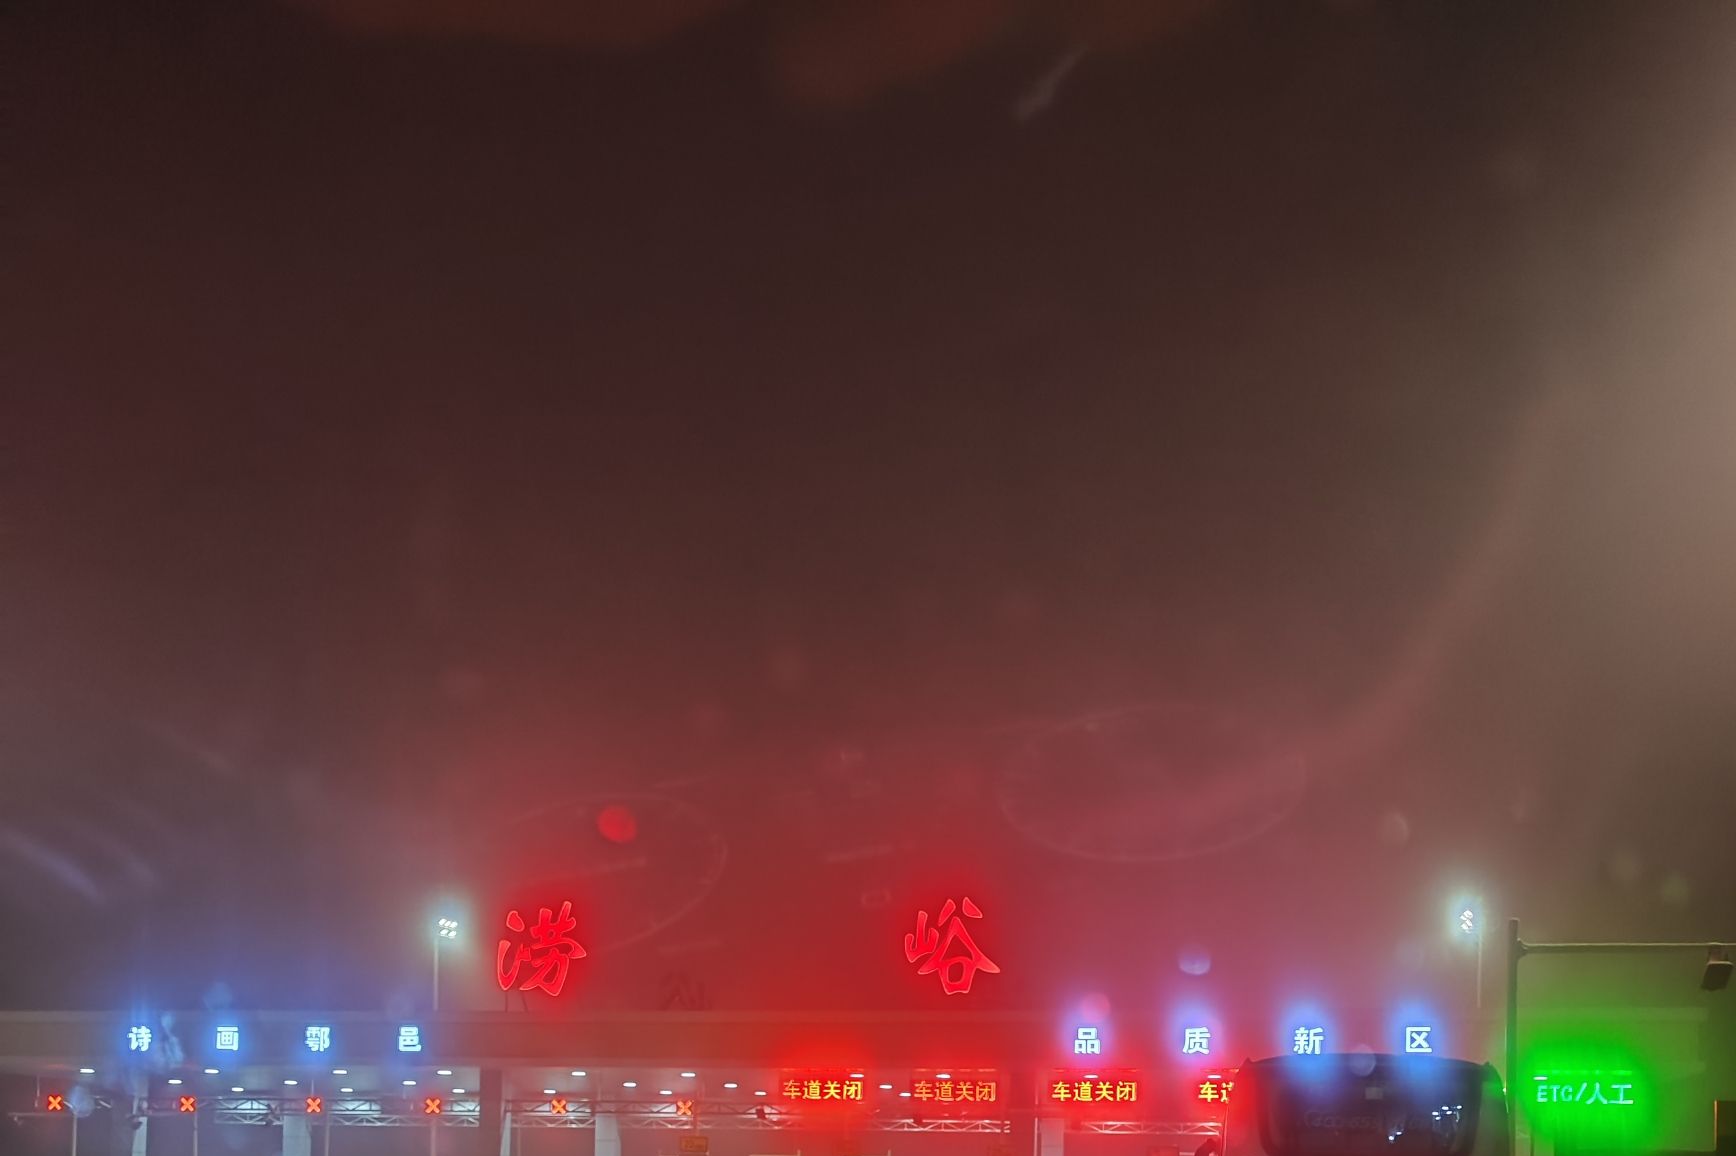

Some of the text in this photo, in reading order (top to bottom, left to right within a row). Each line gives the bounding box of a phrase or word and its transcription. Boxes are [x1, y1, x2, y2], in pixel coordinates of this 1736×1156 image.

[1073, 1026, 1433, 1056] 品质新区
[782, 1080, 864, 1101] 车道关闭
[913, 1080, 997, 1102] 车道关闭
[1051, 1080, 1137, 1102] 车道关闭
[1536, 1081, 1634, 1105] ETC/人工
